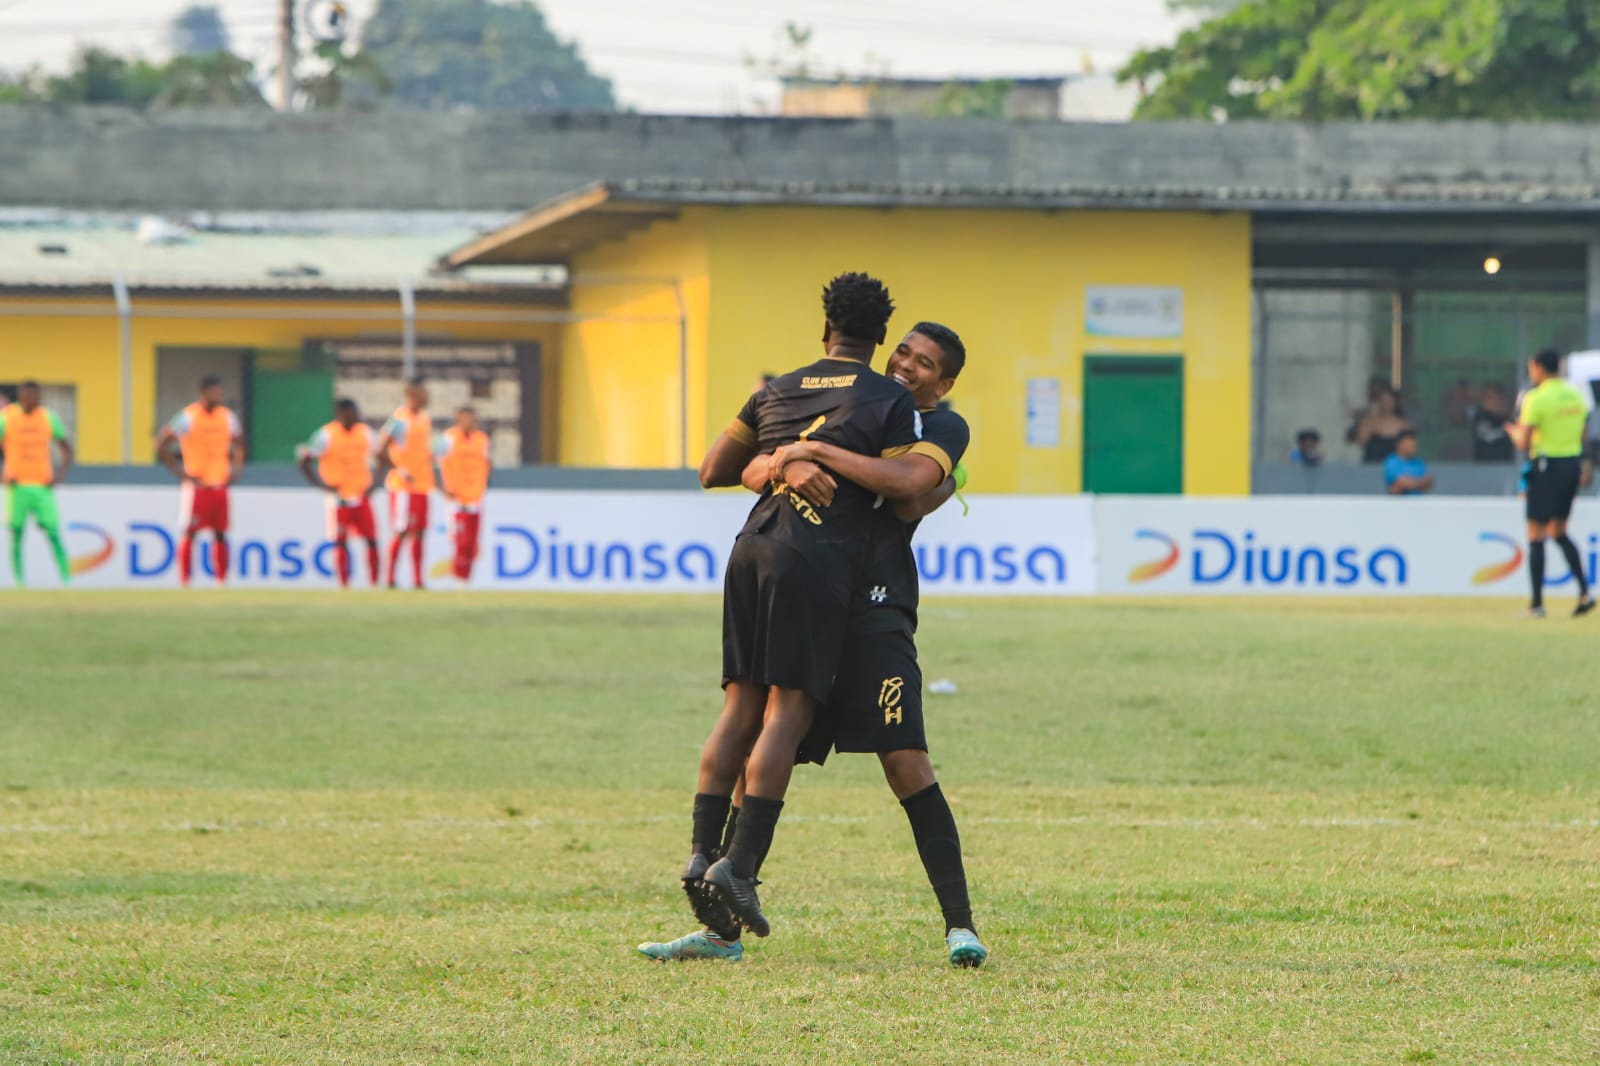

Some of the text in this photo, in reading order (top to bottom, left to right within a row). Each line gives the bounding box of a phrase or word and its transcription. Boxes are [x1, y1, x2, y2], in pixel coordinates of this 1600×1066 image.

[128, 523, 354, 578] Dunsa
[495, 527, 715, 580] Diunsa
[917, 544, 1066, 581] unsa
[1191, 531, 1408, 585] Diunsa
